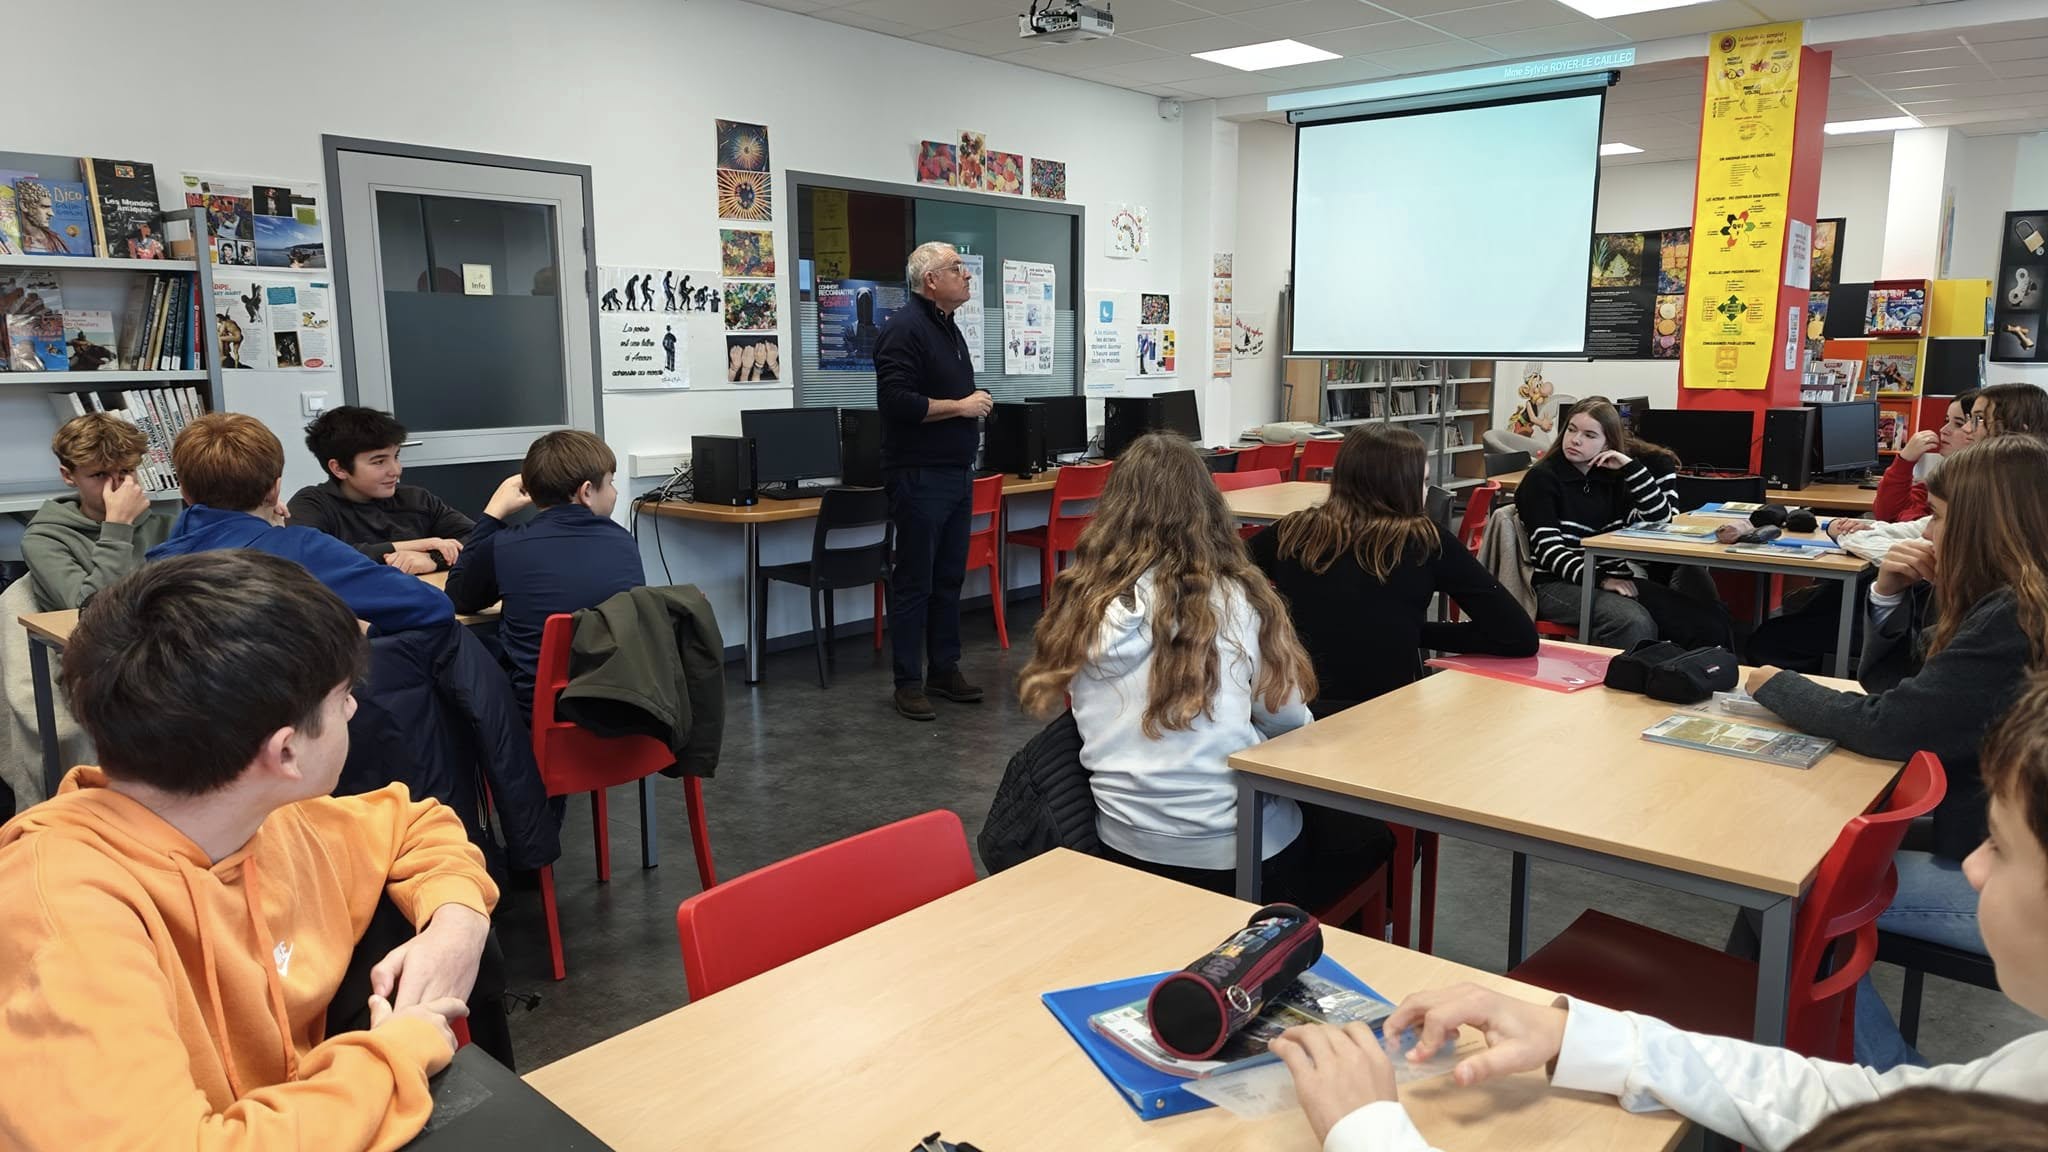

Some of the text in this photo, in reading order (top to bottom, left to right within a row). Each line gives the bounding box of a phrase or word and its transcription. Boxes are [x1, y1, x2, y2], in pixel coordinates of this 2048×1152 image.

[1504, 67, 1523, 78] Mme
[1525, 64, 1549, 77] Sylvie
[1595, 52, 1632, 66] CAILLEC
[104, 197, 155, 207] Les Mondes
[117, 205, 152, 213] Antiques
[471, 282, 486, 290] Info
[622, 322, 633, 332] La
